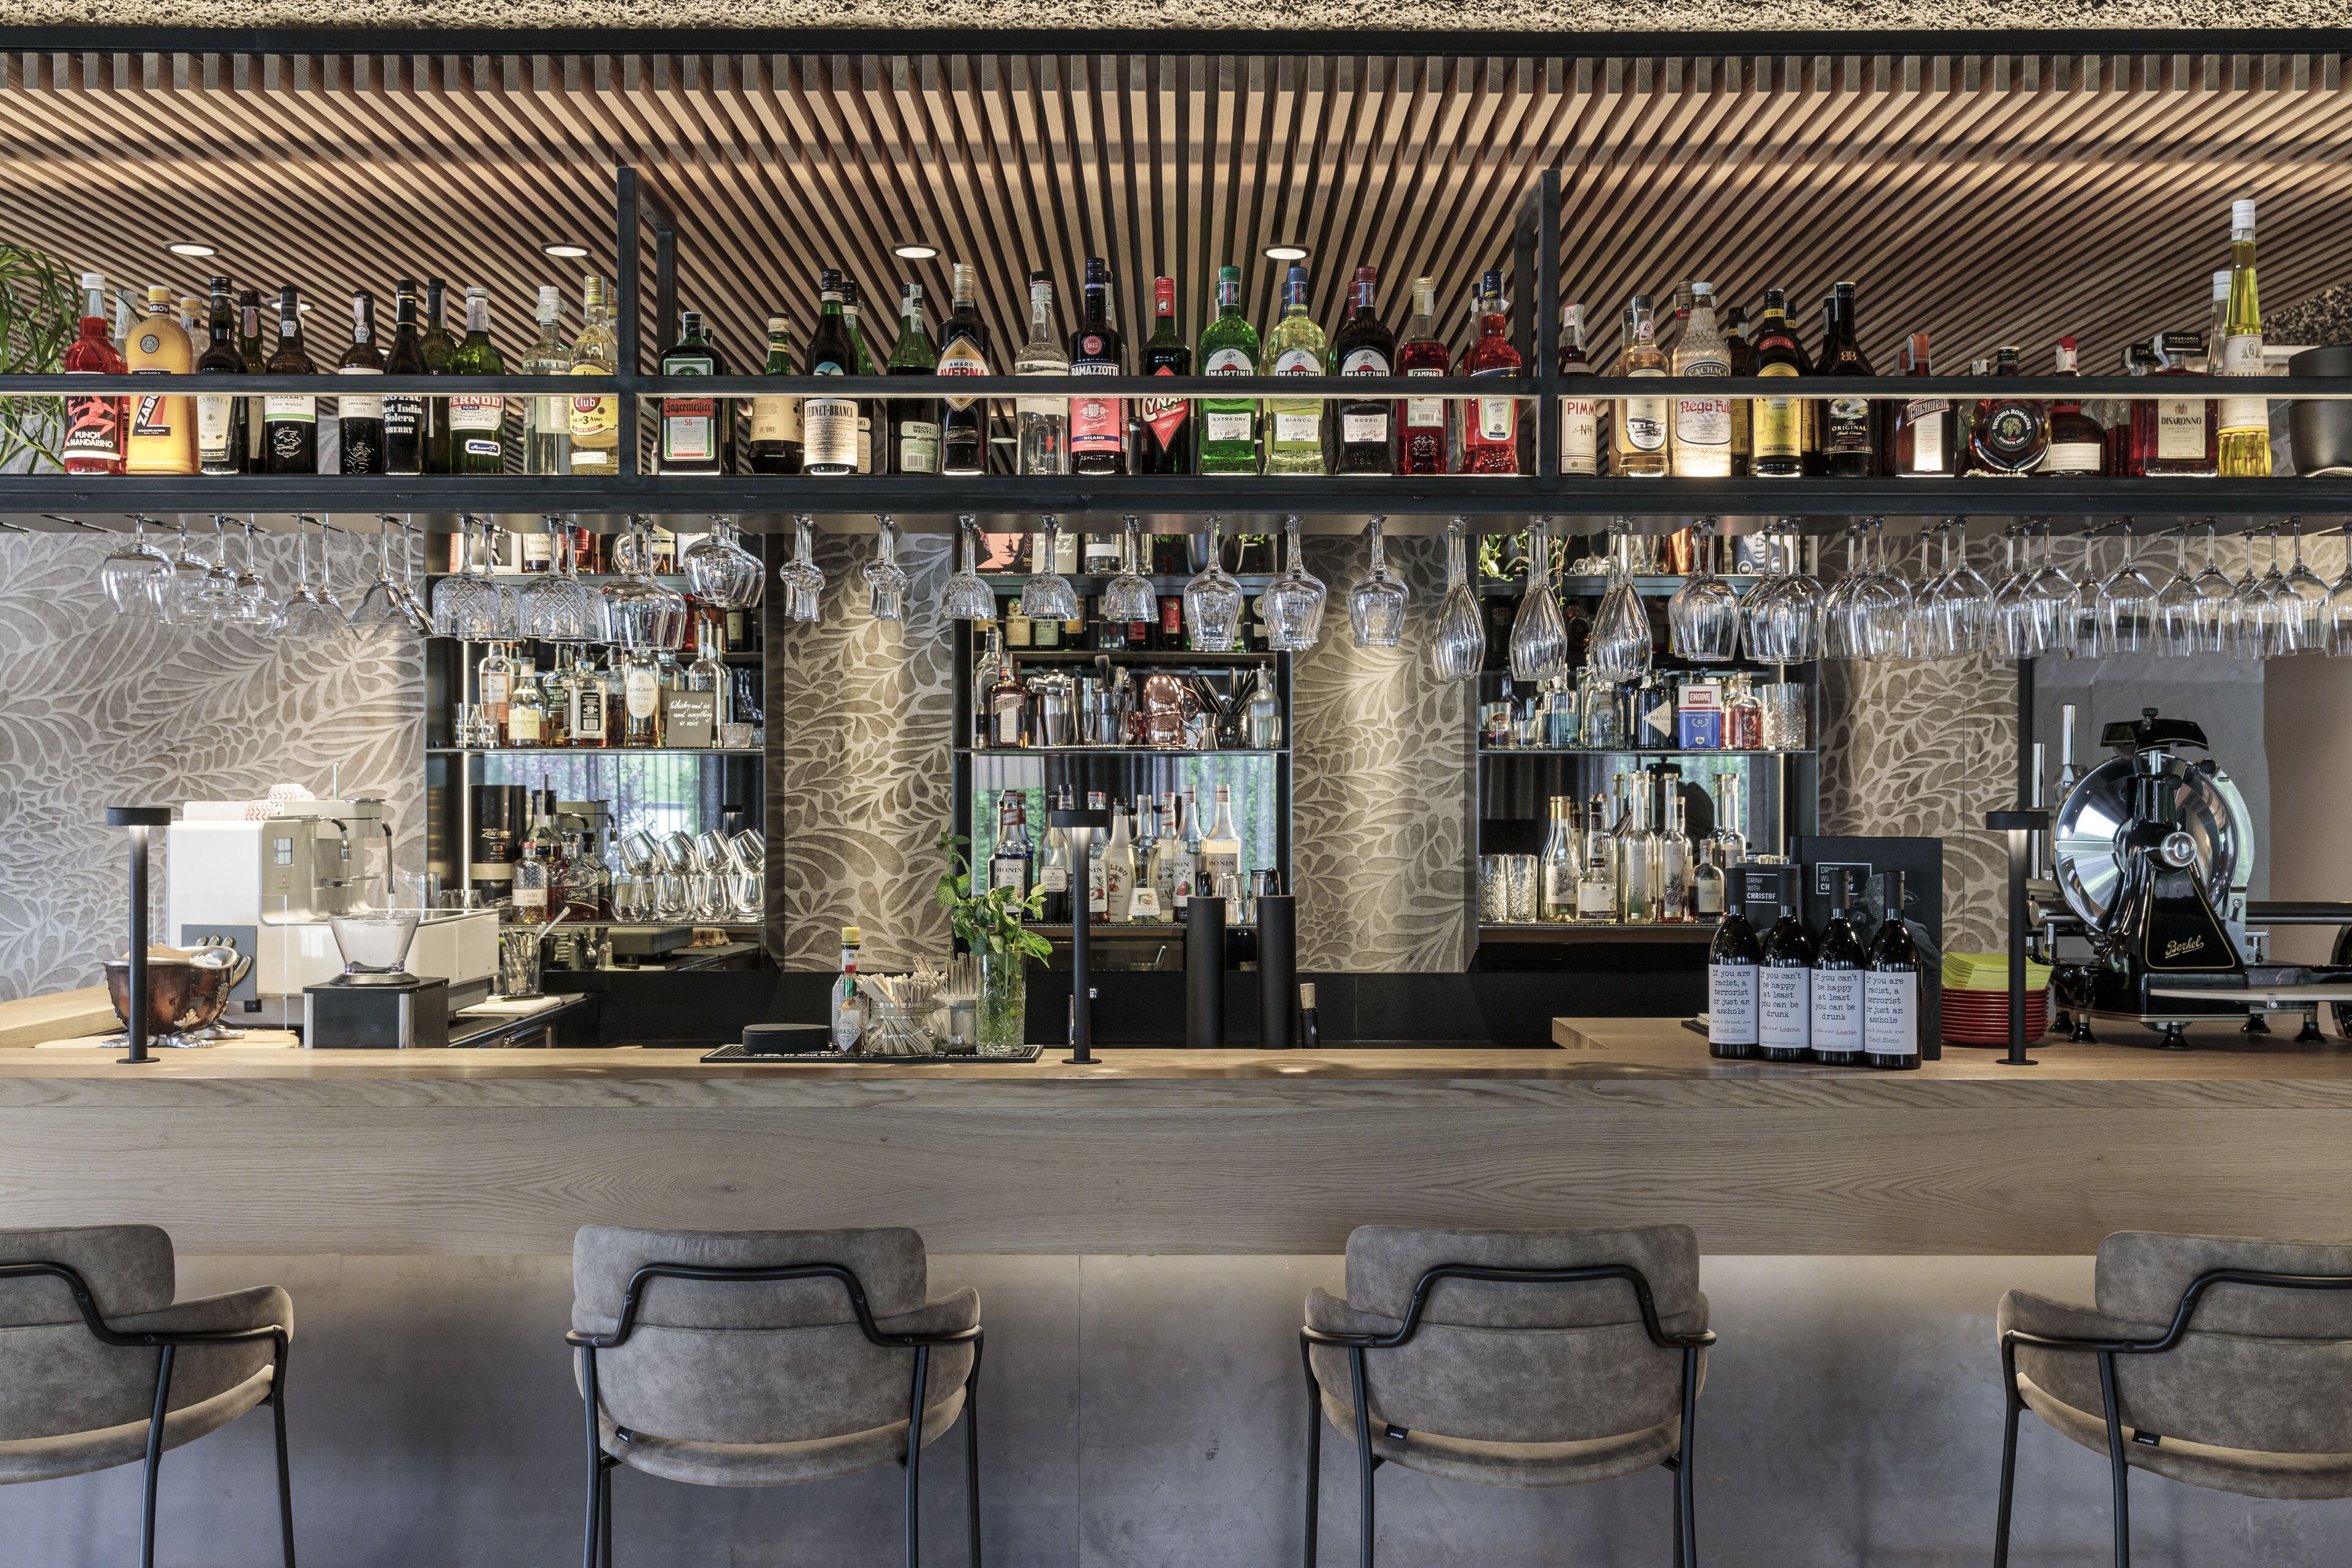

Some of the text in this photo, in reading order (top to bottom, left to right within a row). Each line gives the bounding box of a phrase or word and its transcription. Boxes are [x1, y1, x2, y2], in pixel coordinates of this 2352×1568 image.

[1485, 289, 1498, 298] APEROL
[1764, 339, 1791, 347] IMPORTED
[940, 368, 984, 376] AVERNA
[1072, 365, 1117, 376] RAMAZZOTTI
[1688, 366, 1727, 377] CACHAÇA
[449, 396, 502, 407] PERNOD
[575, 398, 595, 407] Club
[398, 404, 422, 414] India
[807, 405, 853, 418] FERNET-BRANCA
[1909, 399, 1948, 420] COINTREAU
[385, 413, 415, 423] Solera
[1992, 409, 2032, 430] VECCHIA ROMAGNA
[2162, 417, 2201, 426] DISARONNO
[70, 439, 113, 448] MANDARINO
[688, 710, 712, 723] everything
[1110, 865, 1128, 876] LIBU
[2166, 935, 2204, 957] Berkel
[1771, 981, 1796, 990] happy
